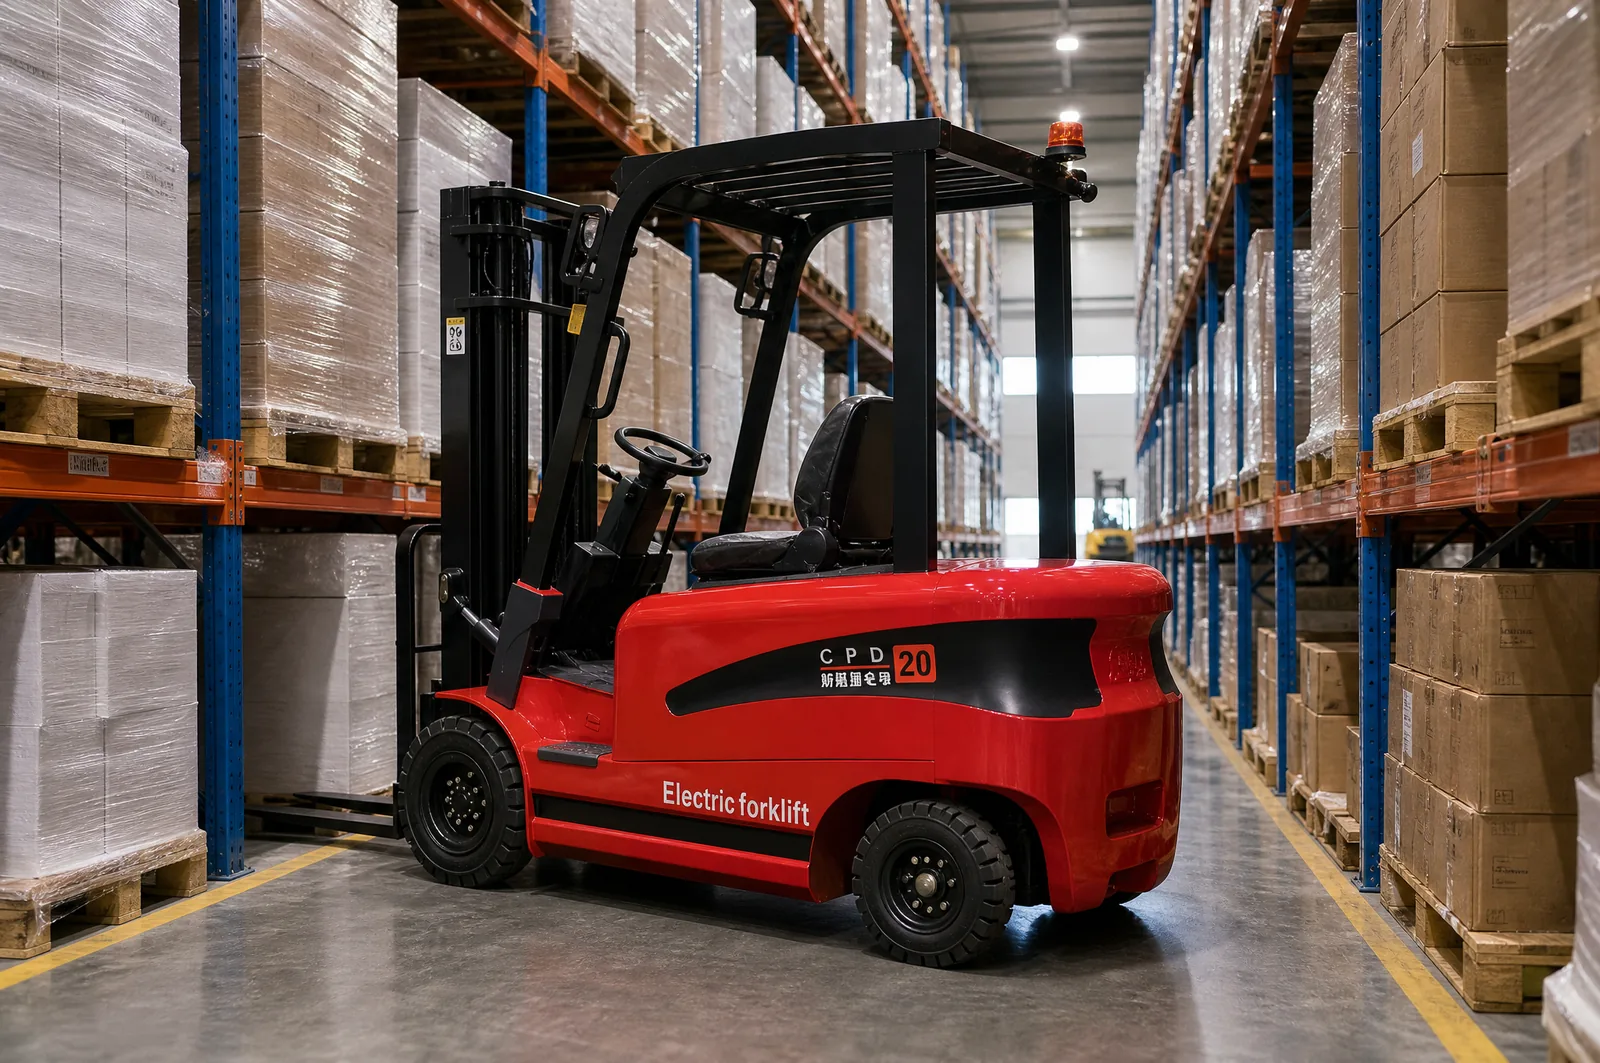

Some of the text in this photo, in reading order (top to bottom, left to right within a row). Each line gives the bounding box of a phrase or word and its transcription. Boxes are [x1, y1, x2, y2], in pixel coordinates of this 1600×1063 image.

[899, 650, 931, 676] 20
[663, 780, 810, 826] Electric forklift
